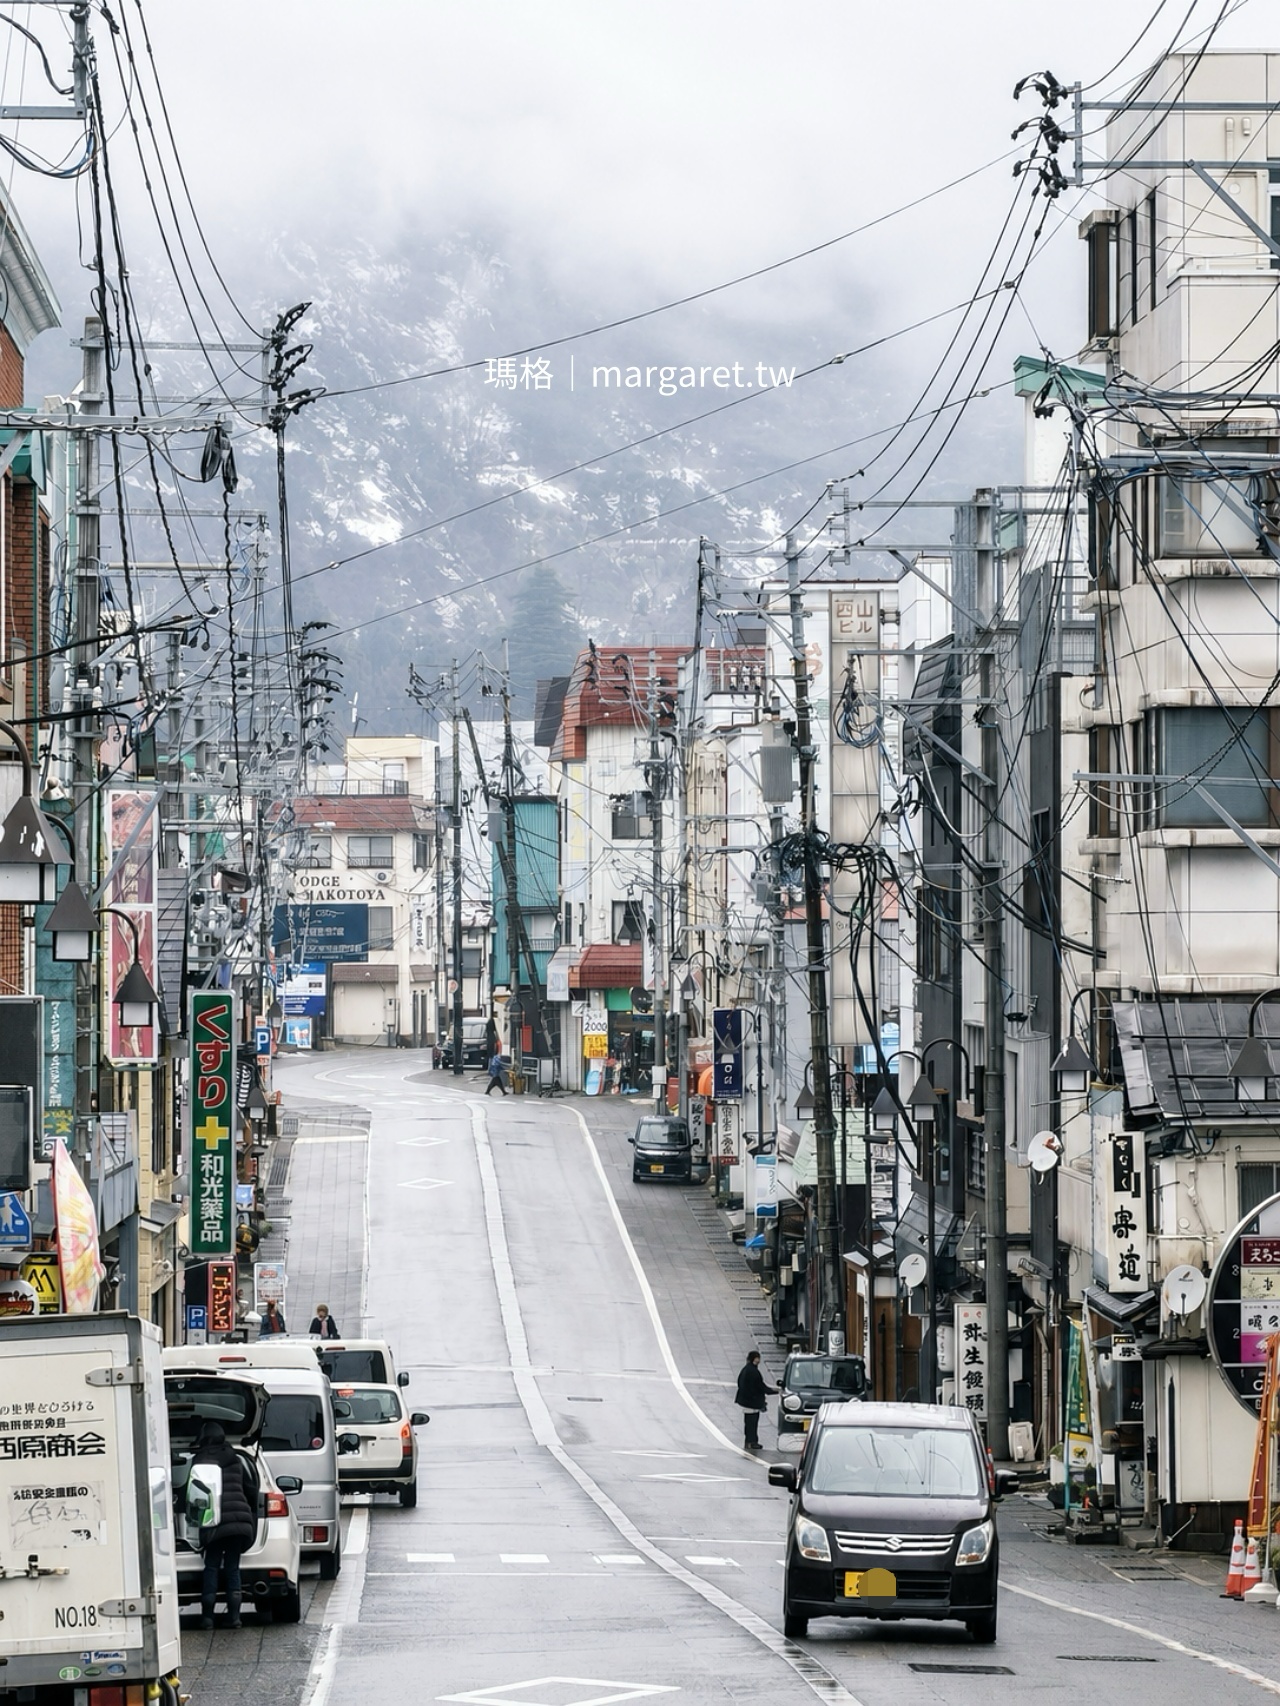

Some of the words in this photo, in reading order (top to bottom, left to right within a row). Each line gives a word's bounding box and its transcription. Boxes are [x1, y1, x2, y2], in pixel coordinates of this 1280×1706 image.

[835, 599, 873, 618] 西山
[840, 620, 873, 634] ビル
[299, 876, 341, 887] ODGE
[257, 1031, 269, 1052] P
[196, 1004, 231, 1109] くすり
[200, 1153, 224, 1243] 和光薬品
[55, 1605, 97, 1628] NO.18
